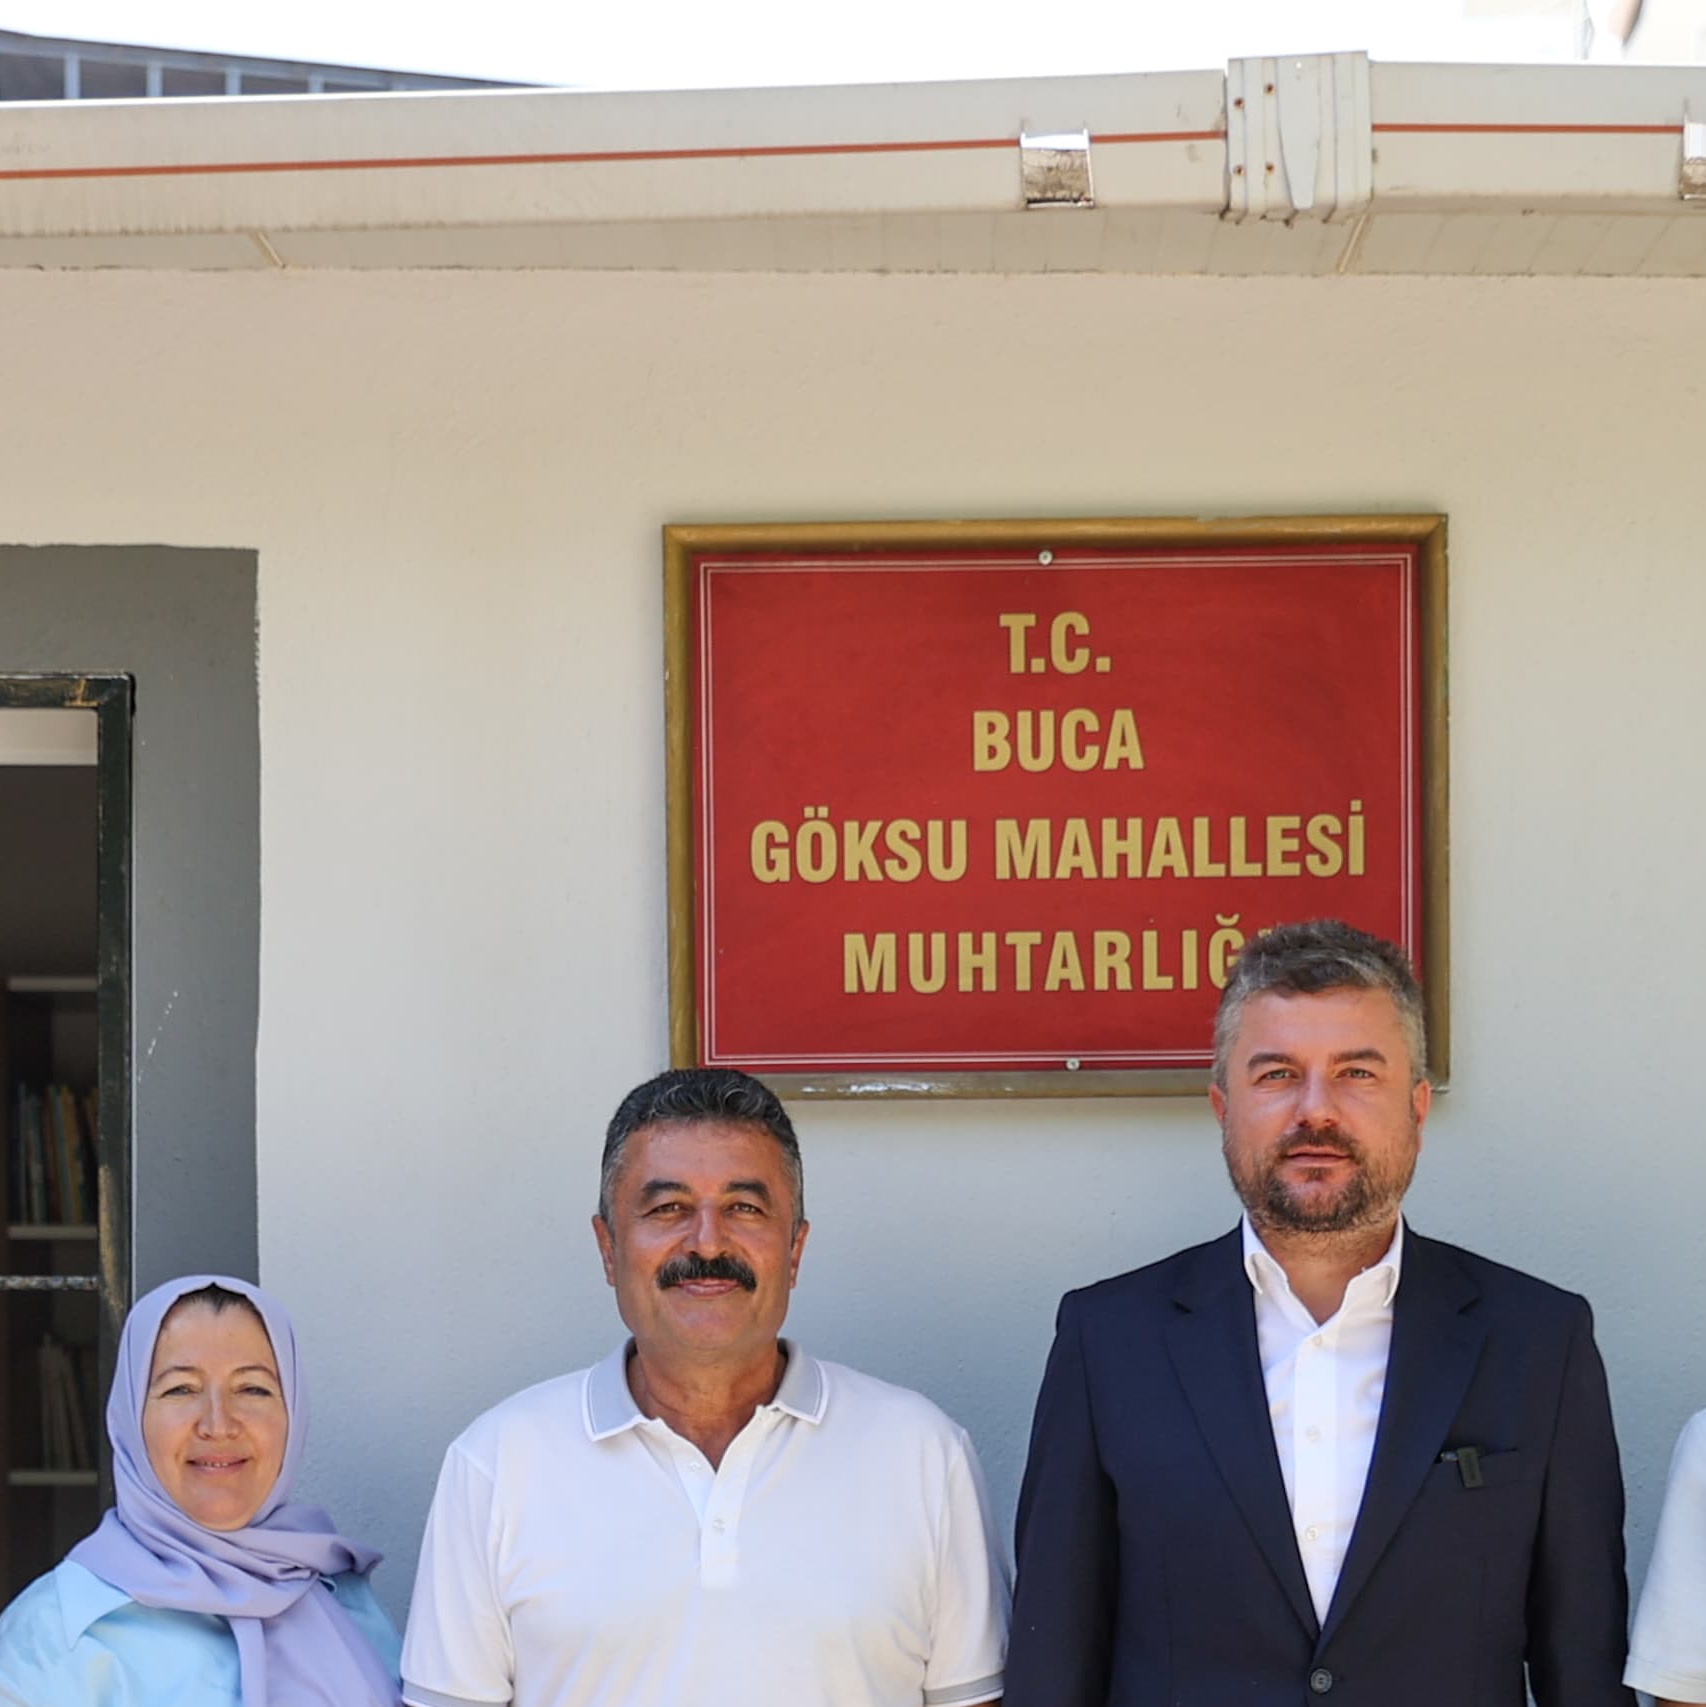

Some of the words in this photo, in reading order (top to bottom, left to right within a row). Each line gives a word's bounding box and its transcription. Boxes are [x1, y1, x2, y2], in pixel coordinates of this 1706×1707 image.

[999, 612, 1112, 675] T.C.
[972, 708, 1145, 772] BUCA
[750, 807, 968, 884] GÖKSU
[994, 799, 1366, 881] MAHALLESİ
[842, 914, 1273, 995] MUHTARLIĞ
